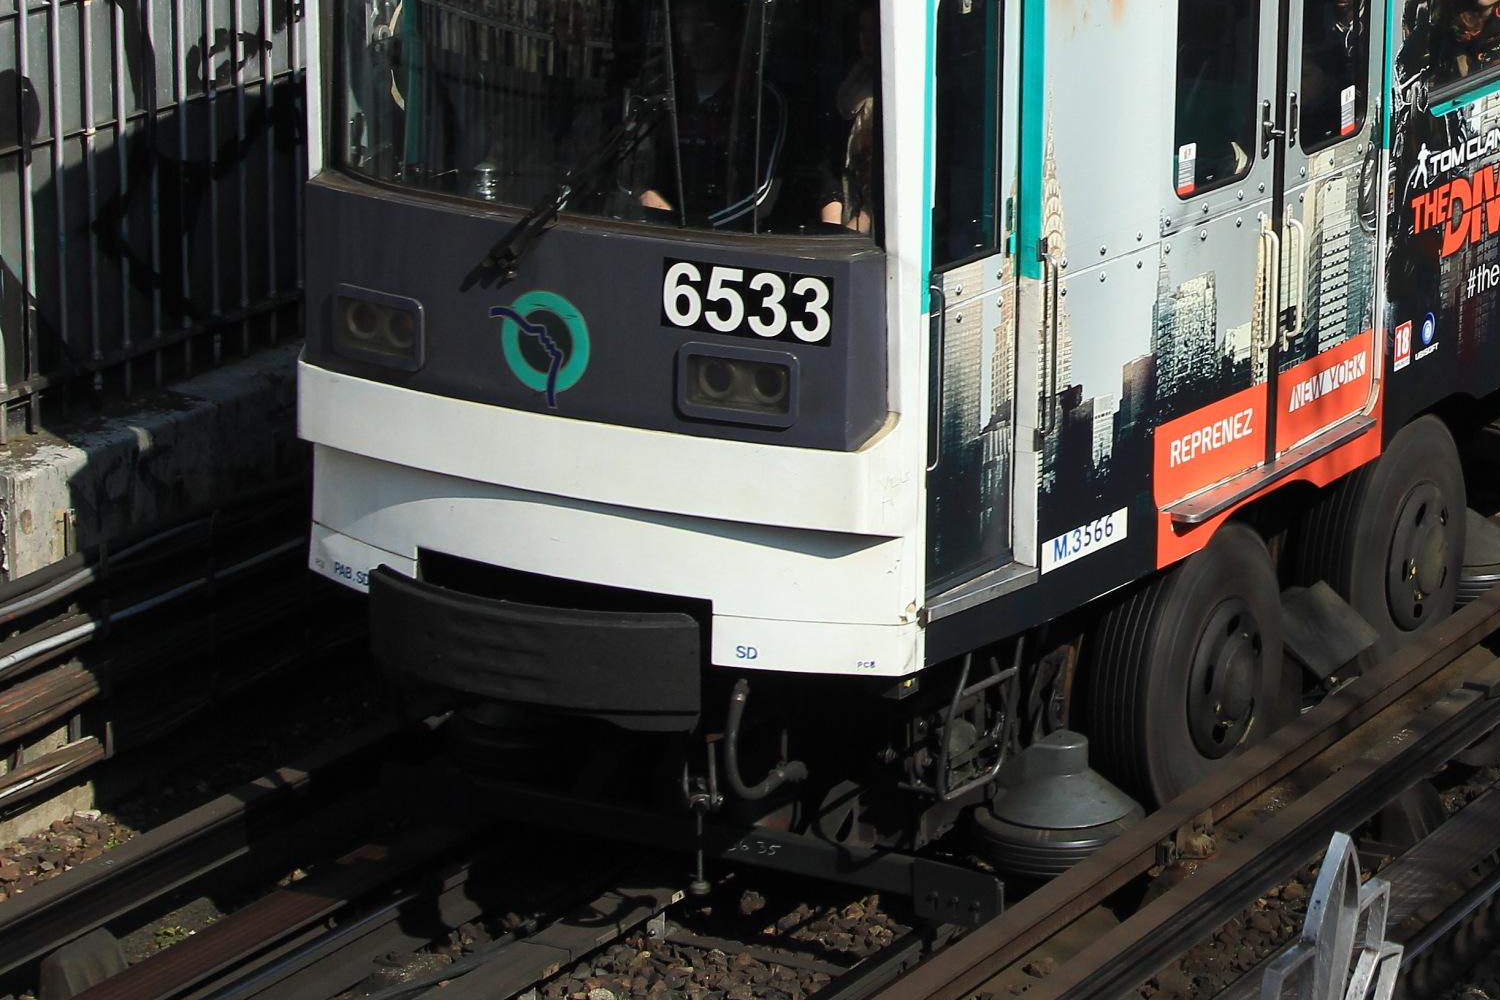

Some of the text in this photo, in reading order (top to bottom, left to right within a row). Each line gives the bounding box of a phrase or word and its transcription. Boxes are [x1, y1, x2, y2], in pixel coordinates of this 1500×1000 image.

[1430, 143, 1465, 176] TOM
[1412, 183, 1452, 235] THE
[663, 262, 831, 343] 6533
[1396, 327, 1410, 358] 18
[1170, 407, 1254, 468] REPRENEZ
[1053, 514, 1115, 562] M.3566
[736, 645, 758, 660] SD
